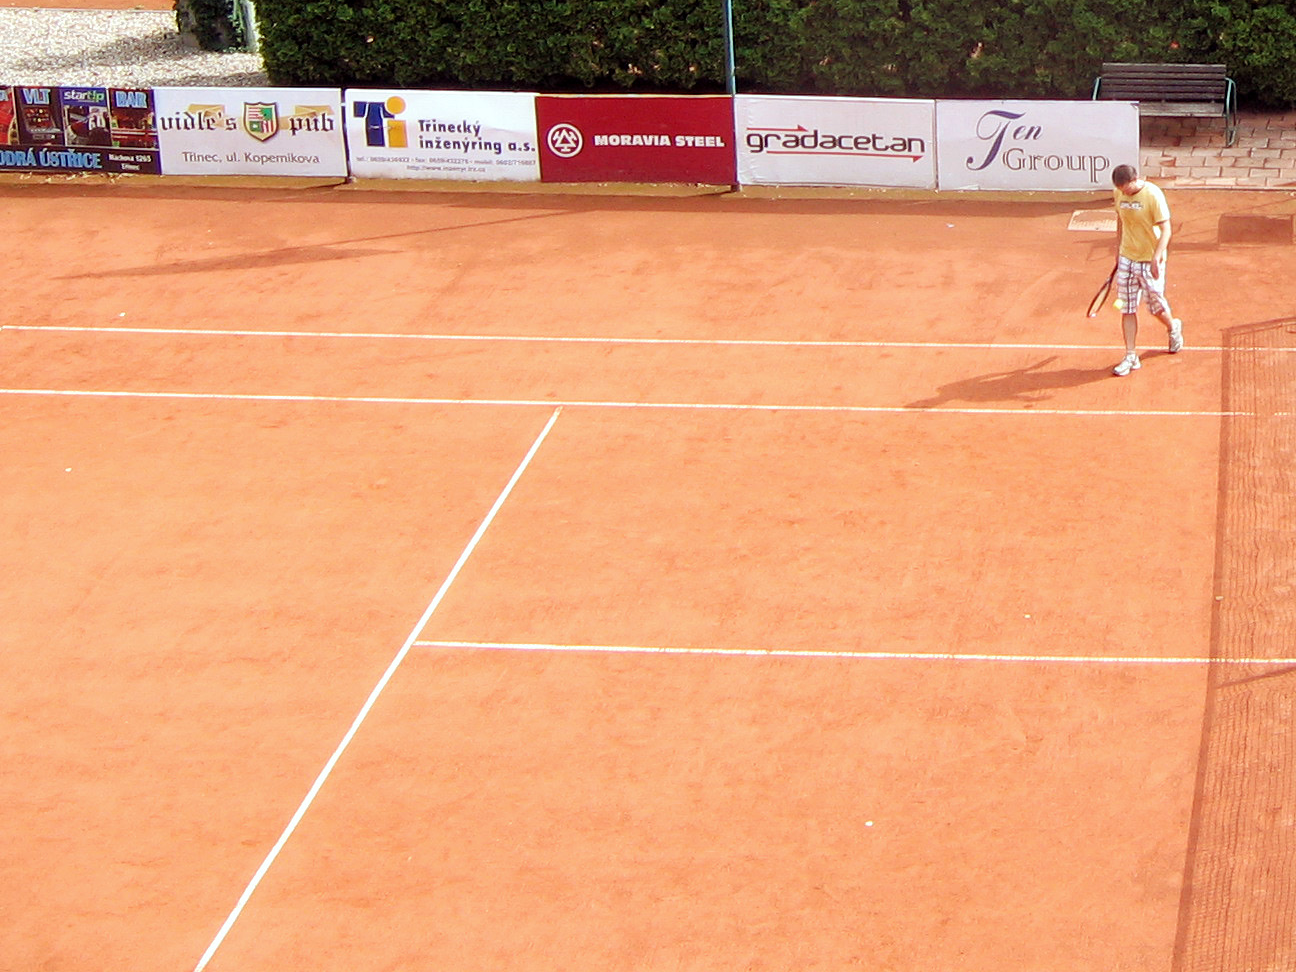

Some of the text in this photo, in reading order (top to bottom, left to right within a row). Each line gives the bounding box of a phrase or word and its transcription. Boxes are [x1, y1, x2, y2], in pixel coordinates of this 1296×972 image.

[22, 88, 51, 105] VLT
[115, 91, 148, 109] BAR
[289, 113, 335, 136] pub
[418, 118, 481, 137] Třinecký
[419, 135, 537, 154] inženýring a.s.
[594, 134, 725, 148] MORAVIA STEEL
[746, 129, 926, 154] gradacetan
[1001, 147, 1111, 183] Group
